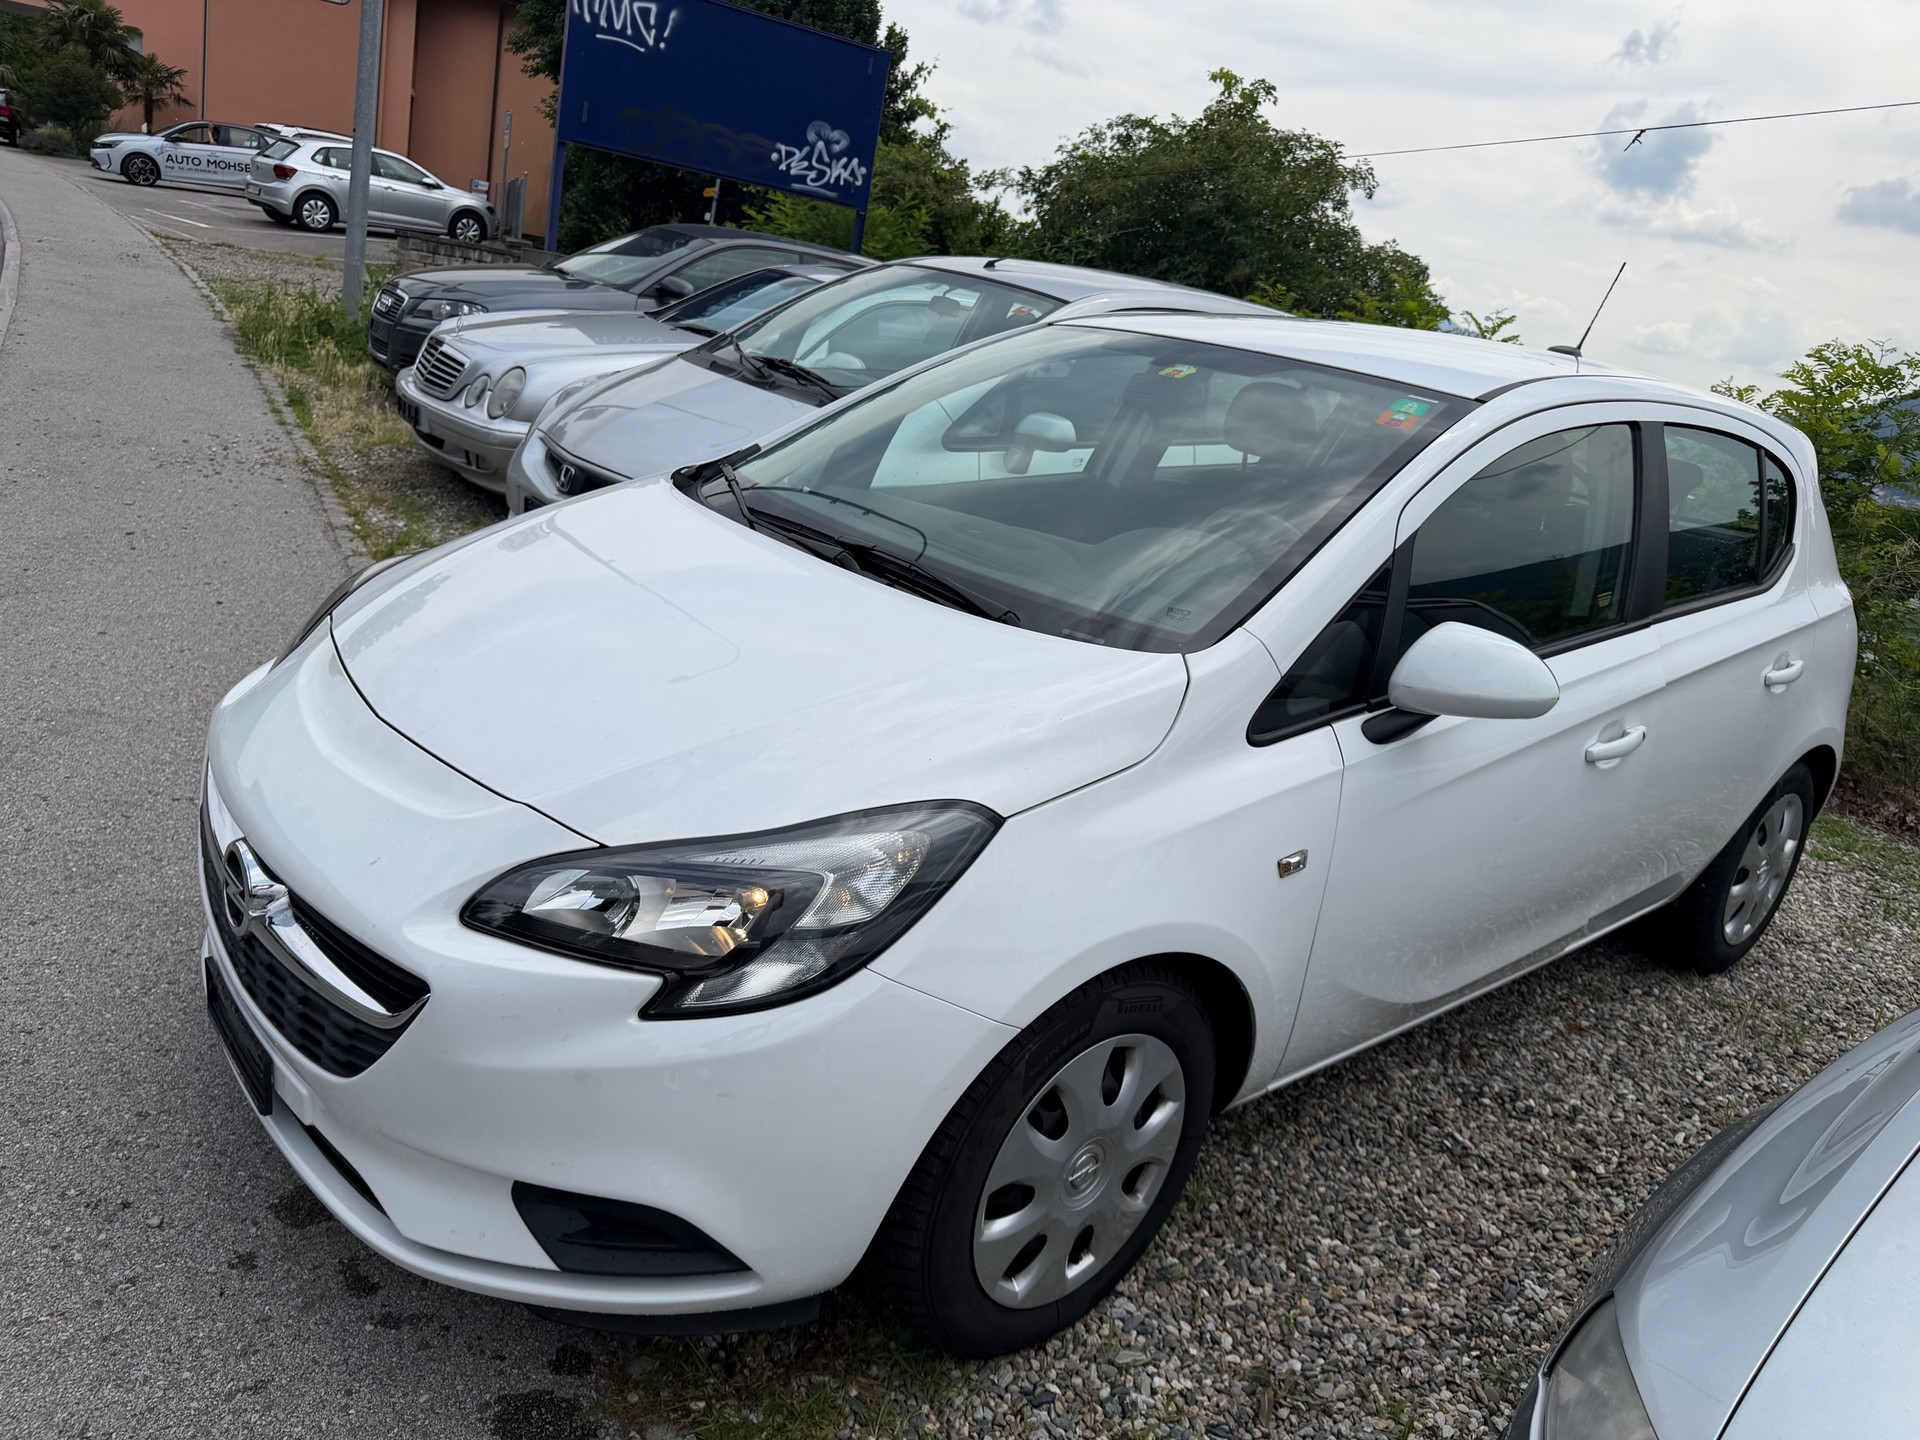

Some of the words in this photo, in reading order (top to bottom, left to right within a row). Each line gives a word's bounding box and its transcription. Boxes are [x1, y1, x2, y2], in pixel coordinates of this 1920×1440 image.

[165, 153, 202, 167] AUTO
[1117, 995, 1164, 1016] PIRELLI
[1027, 1022, 1092, 1077] WINTER
